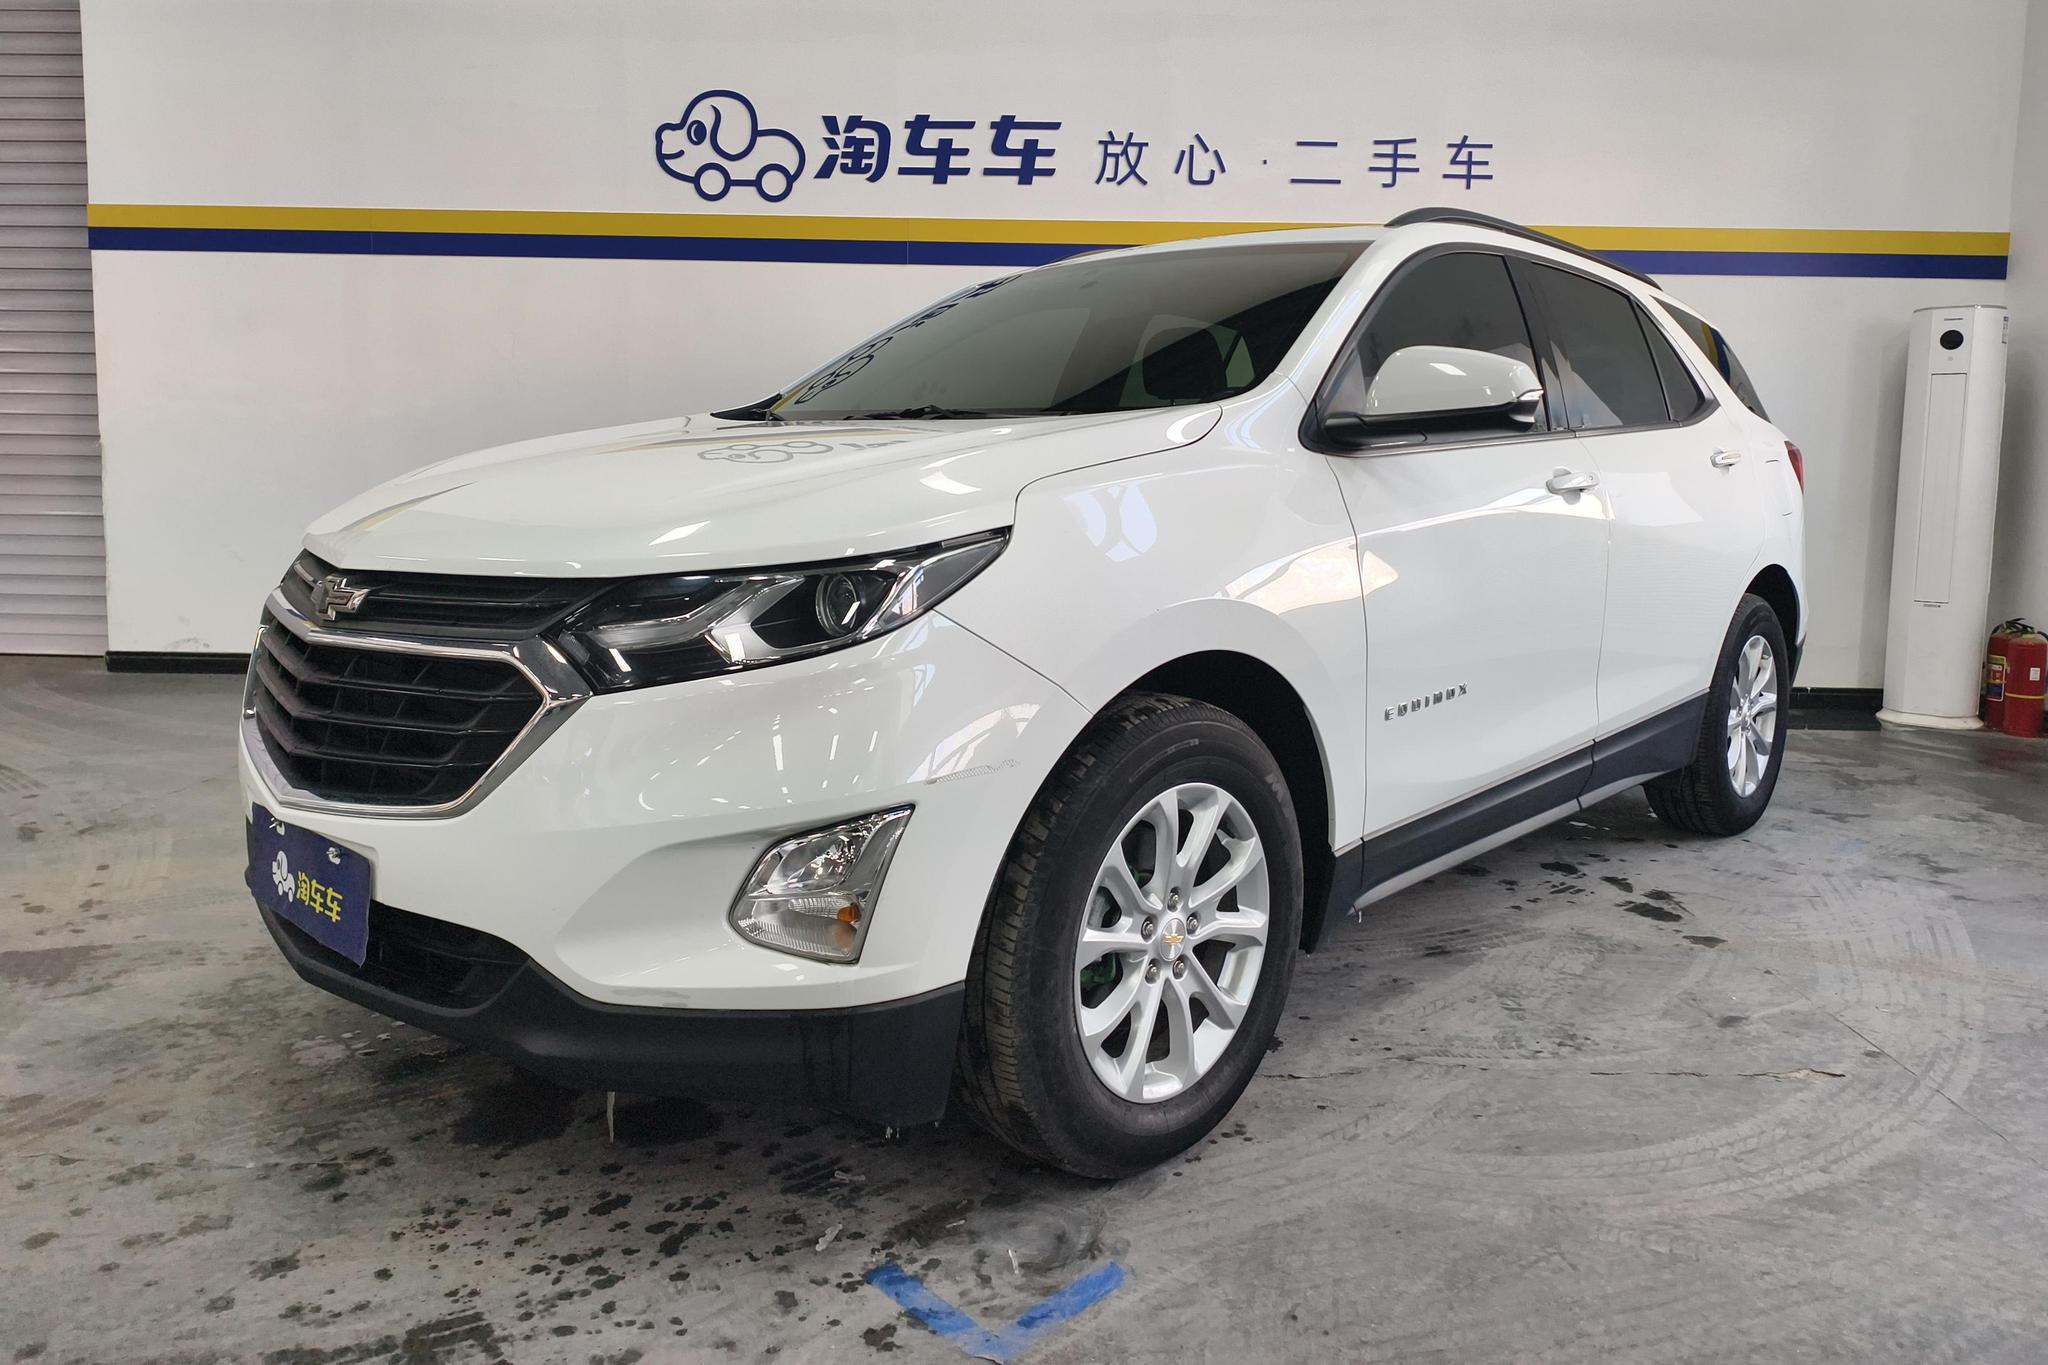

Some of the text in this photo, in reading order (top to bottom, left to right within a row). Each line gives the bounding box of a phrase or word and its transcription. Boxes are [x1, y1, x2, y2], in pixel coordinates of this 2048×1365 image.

[814, 114, 1062, 186] 淘车车
[296, 871, 343, 923] 淘车车
